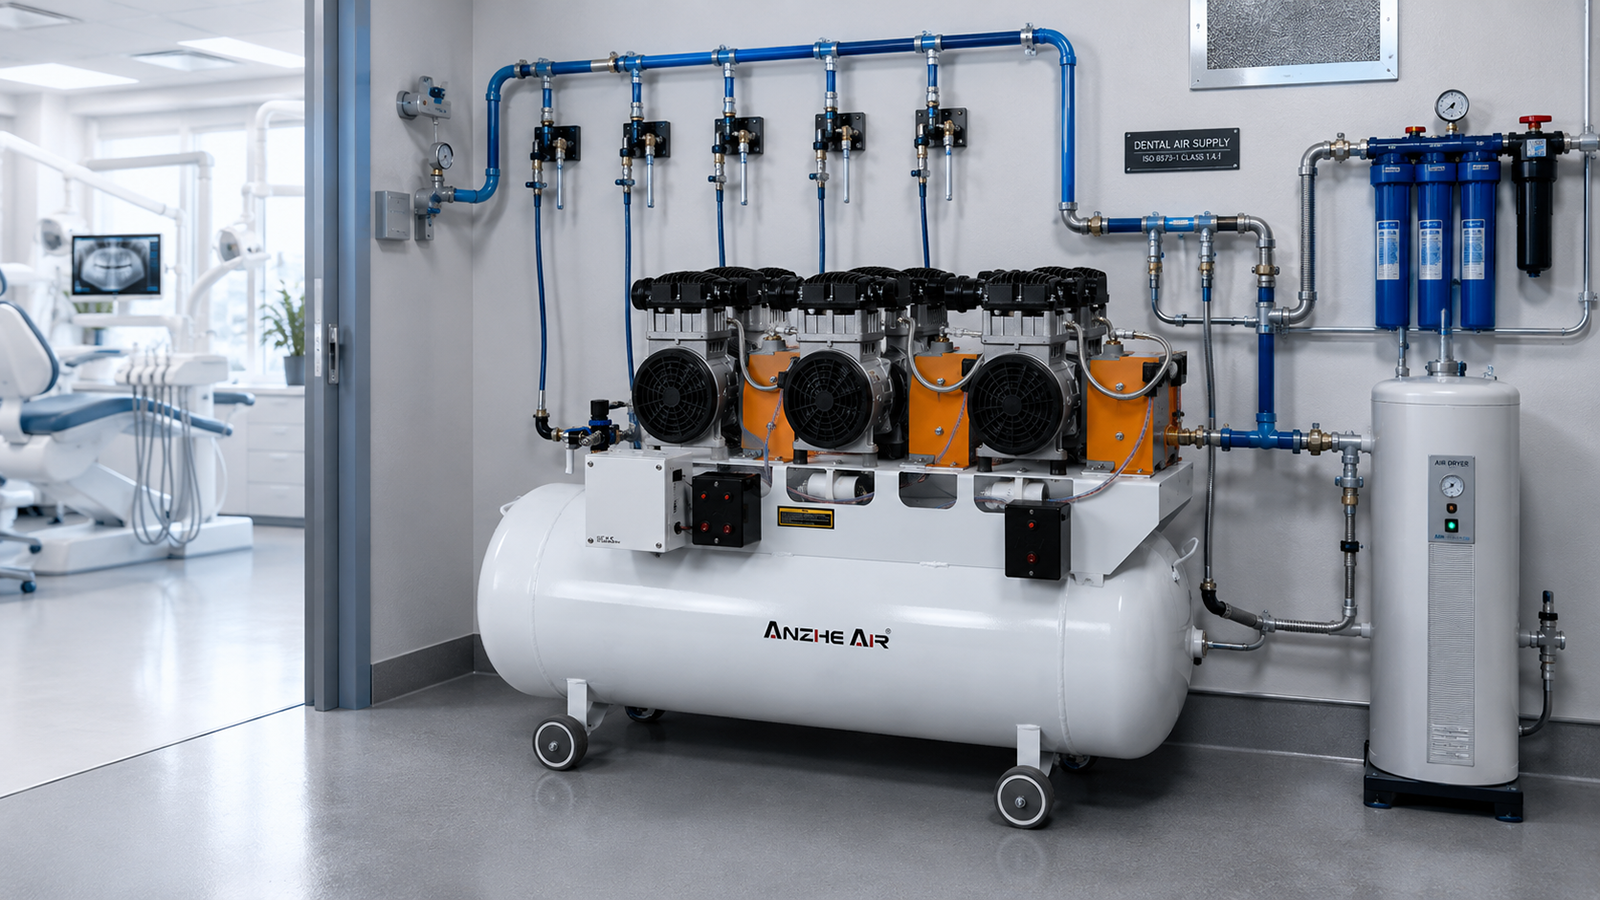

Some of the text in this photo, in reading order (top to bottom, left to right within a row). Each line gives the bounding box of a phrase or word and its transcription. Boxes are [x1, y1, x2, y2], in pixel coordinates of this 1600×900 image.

[1134, 138, 1230, 150] DENTAL AIR SUPPLY
[1142, 154, 1155, 163] ISO
[1180, 152, 1204, 161] CLASS
[763, 620, 890, 650] ANZHE AIR
